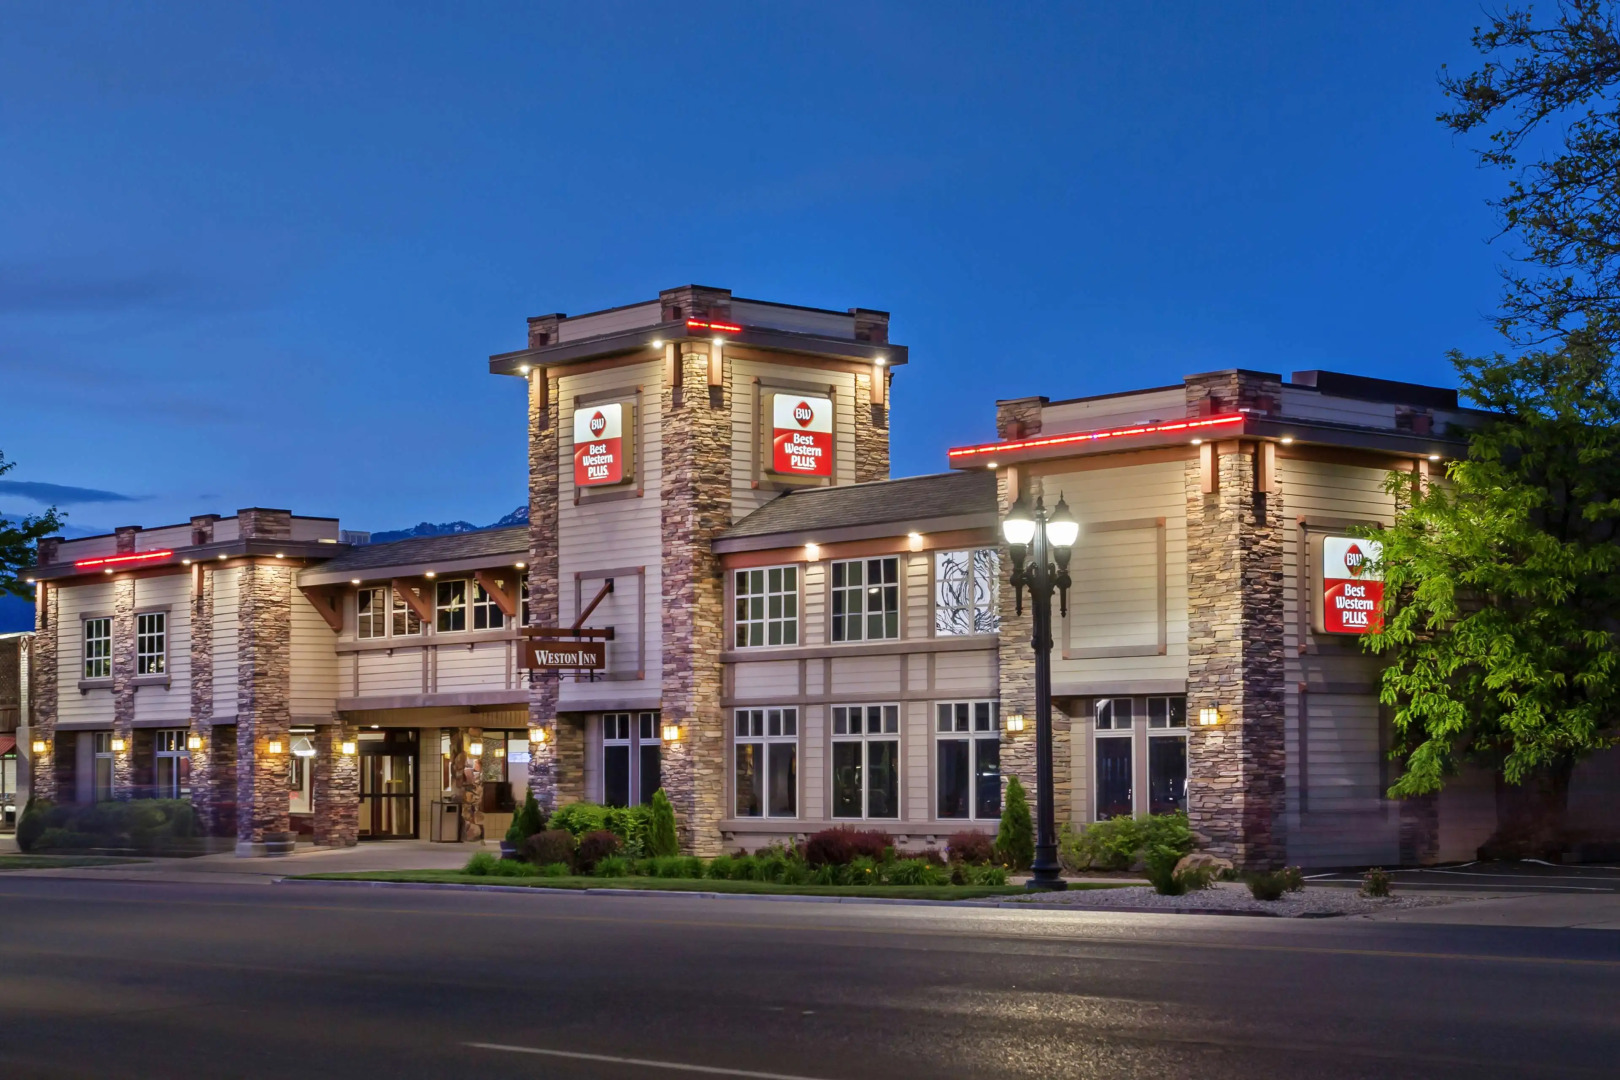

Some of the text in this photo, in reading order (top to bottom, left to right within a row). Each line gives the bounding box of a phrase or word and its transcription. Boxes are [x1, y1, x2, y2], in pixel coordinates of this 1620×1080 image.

[795, 408, 811, 420] BW
[591, 418, 604, 430] BW
[793, 433, 814, 445] Best
[589, 443, 606, 455] Best
[784, 442, 822, 457] Western
[582, 454, 613, 466] Western
[1344, 583, 1365, 597] Best
[1336, 596, 1374, 610] Western
[534, 650, 597, 665] WESTON INN
